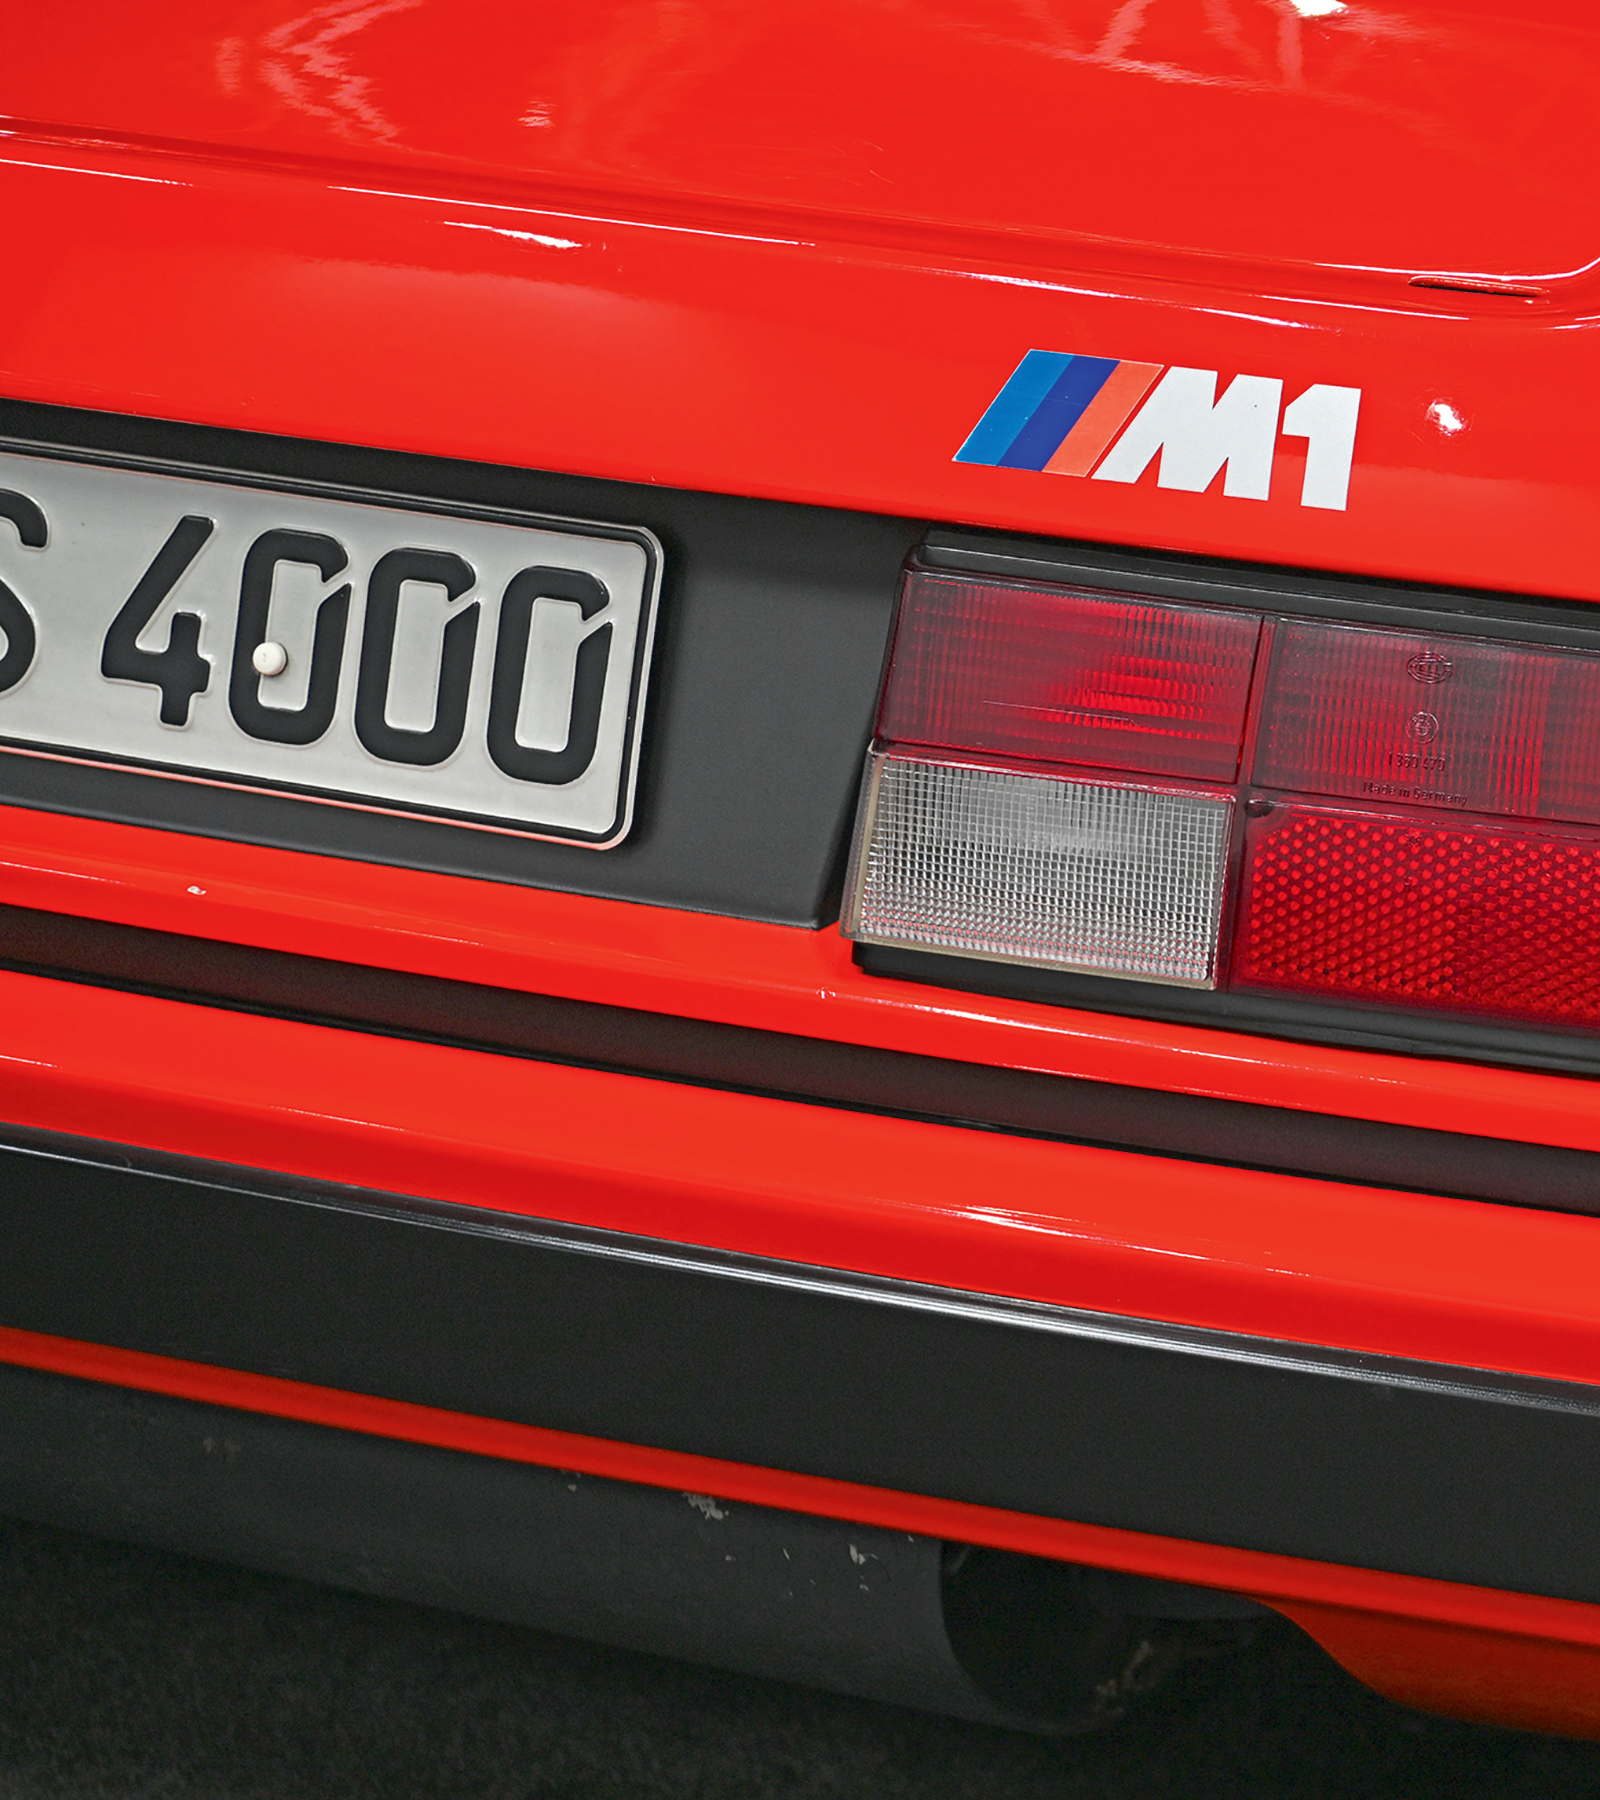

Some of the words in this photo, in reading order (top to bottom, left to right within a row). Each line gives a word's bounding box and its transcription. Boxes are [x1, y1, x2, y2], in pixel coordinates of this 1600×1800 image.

[1091, 366, 1361, 511] M1
[101, 514, 614, 786] 4000
[1362, 781, 1396, 796] Made
[1399, 787, 1410, 798] in
[1413, 786, 1469, 807] Germany
